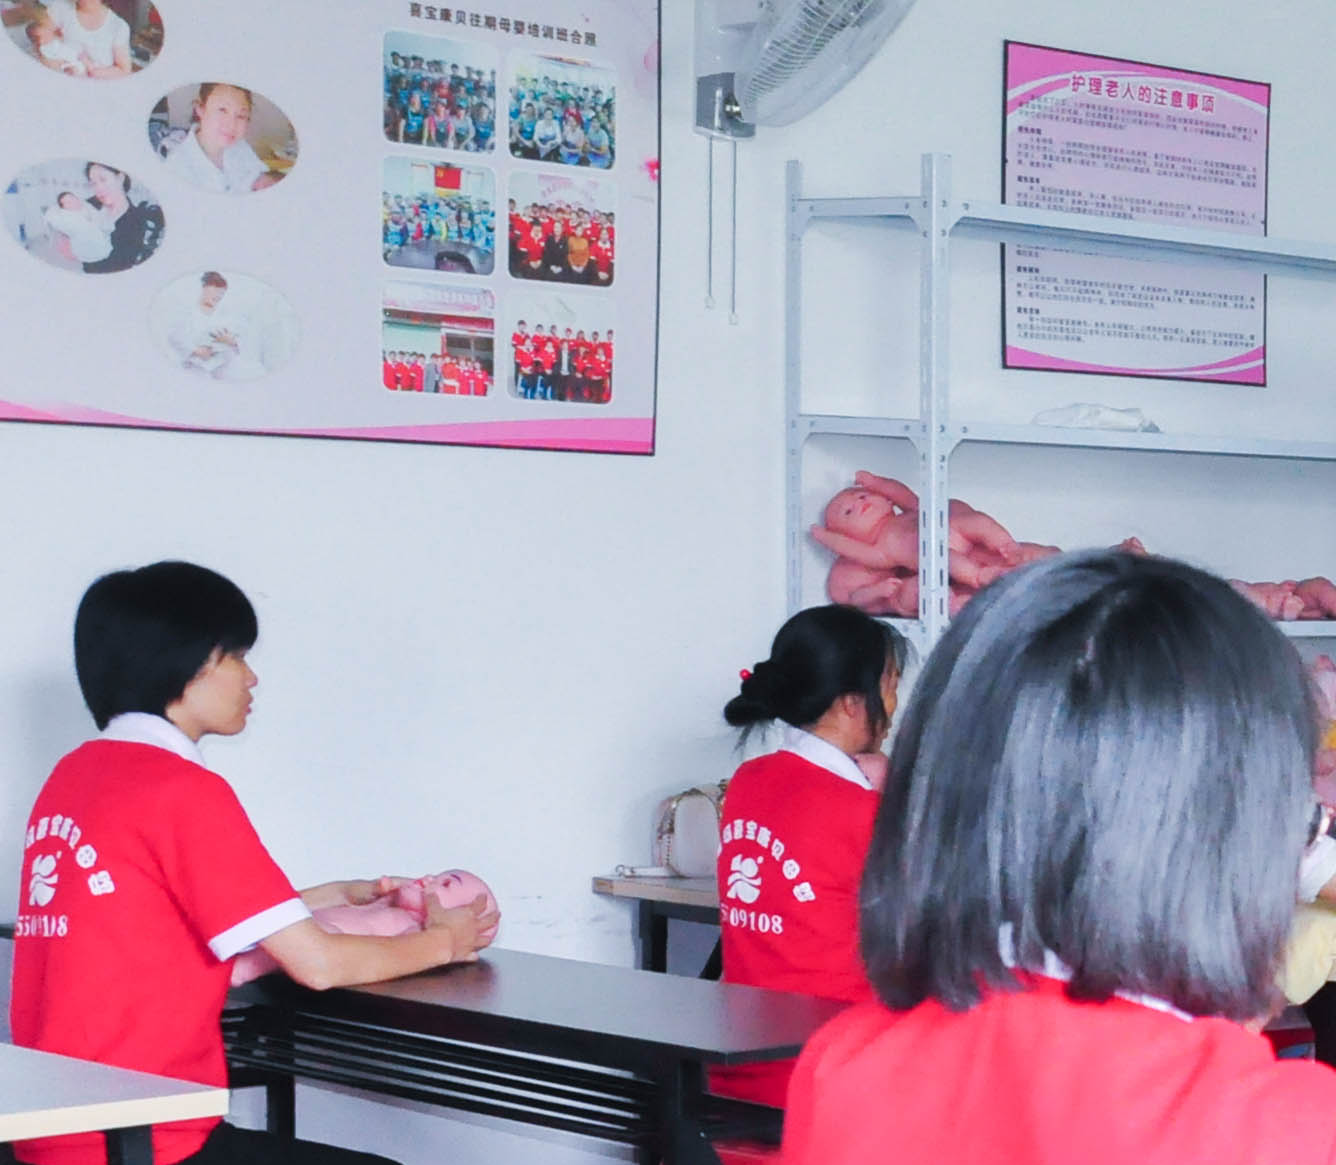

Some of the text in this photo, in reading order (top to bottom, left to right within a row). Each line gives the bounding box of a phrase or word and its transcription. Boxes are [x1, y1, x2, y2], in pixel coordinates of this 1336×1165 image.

[1071, 73, 1216, 114] 护理老人的注意事项
